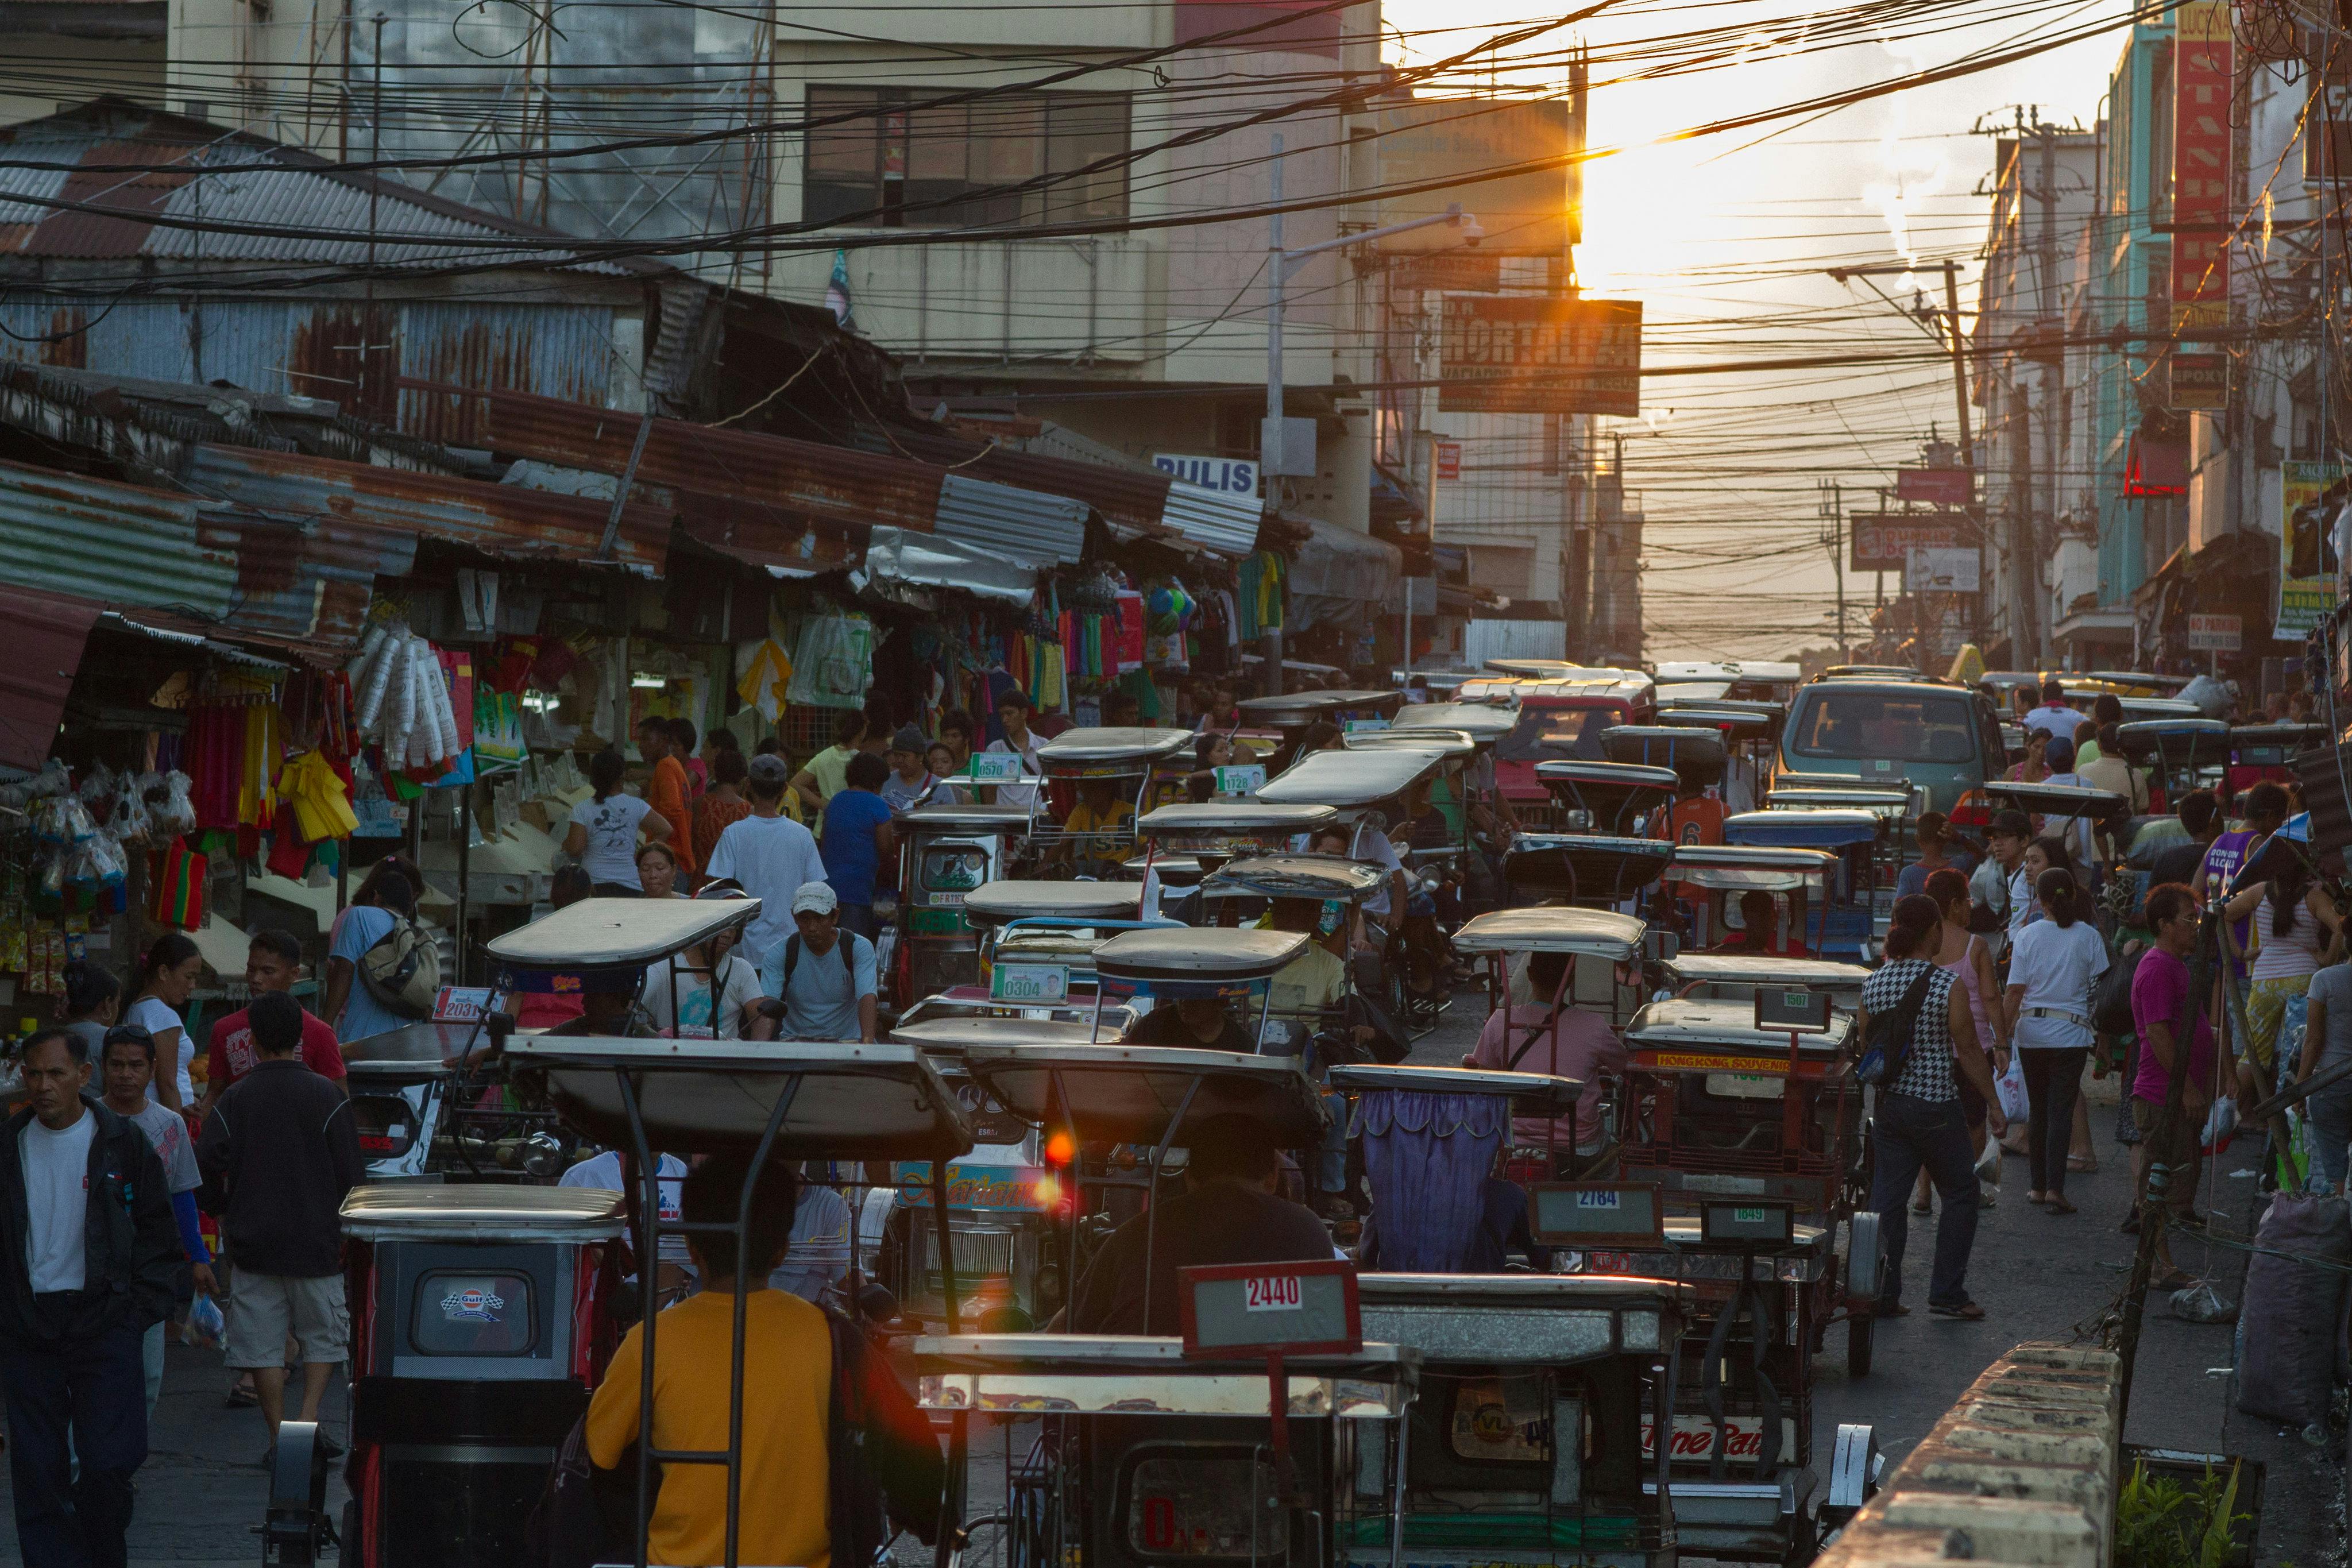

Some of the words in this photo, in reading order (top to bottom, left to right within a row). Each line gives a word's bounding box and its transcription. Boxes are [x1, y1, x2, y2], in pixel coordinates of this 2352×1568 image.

[1441, 318, 1638, 366] HORTALEZA
[979, 765, 1002, 775] 0570
[1226, 778, 1248, 789] 1728
[1681, 821, 1701, 845] 6
[1005, 980, 1040, 997] 0304
[1786, 994, 1806, 1006] 1507
[446, 1002, 478, 1017] 2031
[1247, 1276, 1301, 1307] 2440
